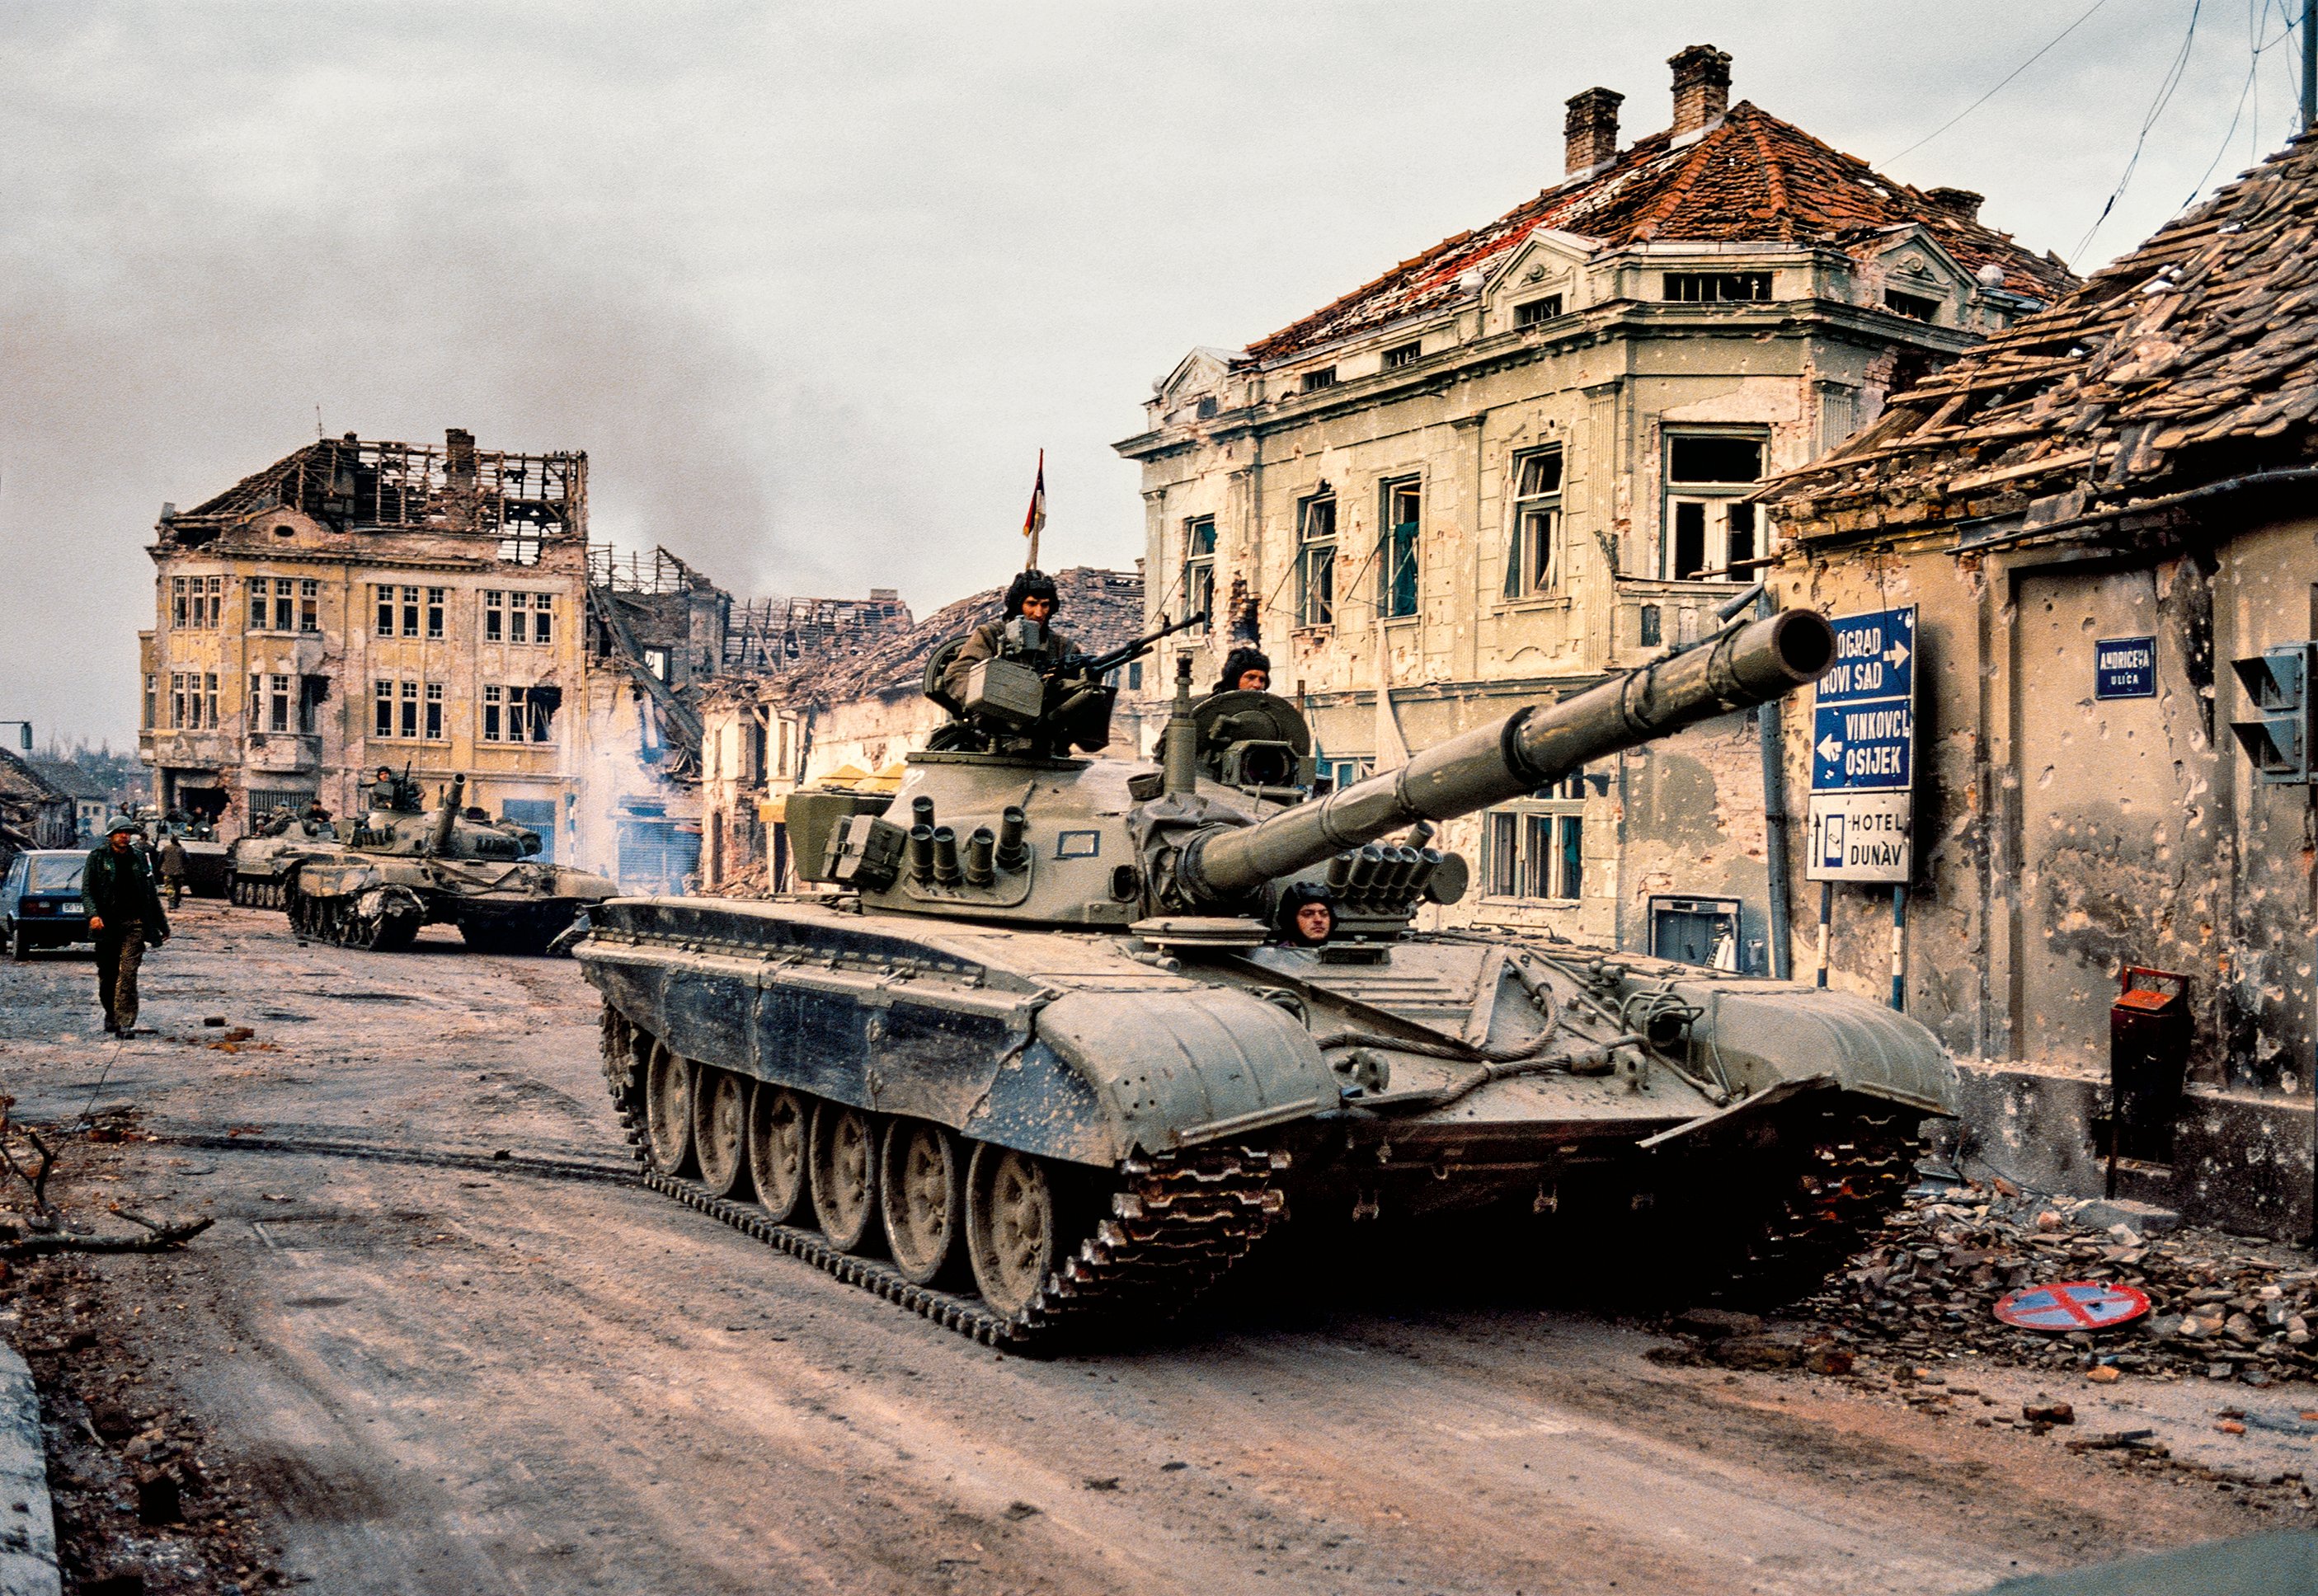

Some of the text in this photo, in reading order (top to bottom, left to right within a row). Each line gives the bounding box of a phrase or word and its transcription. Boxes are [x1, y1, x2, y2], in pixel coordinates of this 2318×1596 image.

[1836, 627, 1881, 659] OGRAD
[1819, 661, 1883, 694] NOVI SAD
[2110, 674, 2139, 686] ULICA
[1845, 709, 1907, 741] VINKOVCI
[1845, 746, 1902, 776] OSIJEK
[1852, 813, 1903, 831] HOTEL
[1850, 843, 1902, 866] DUNAV
